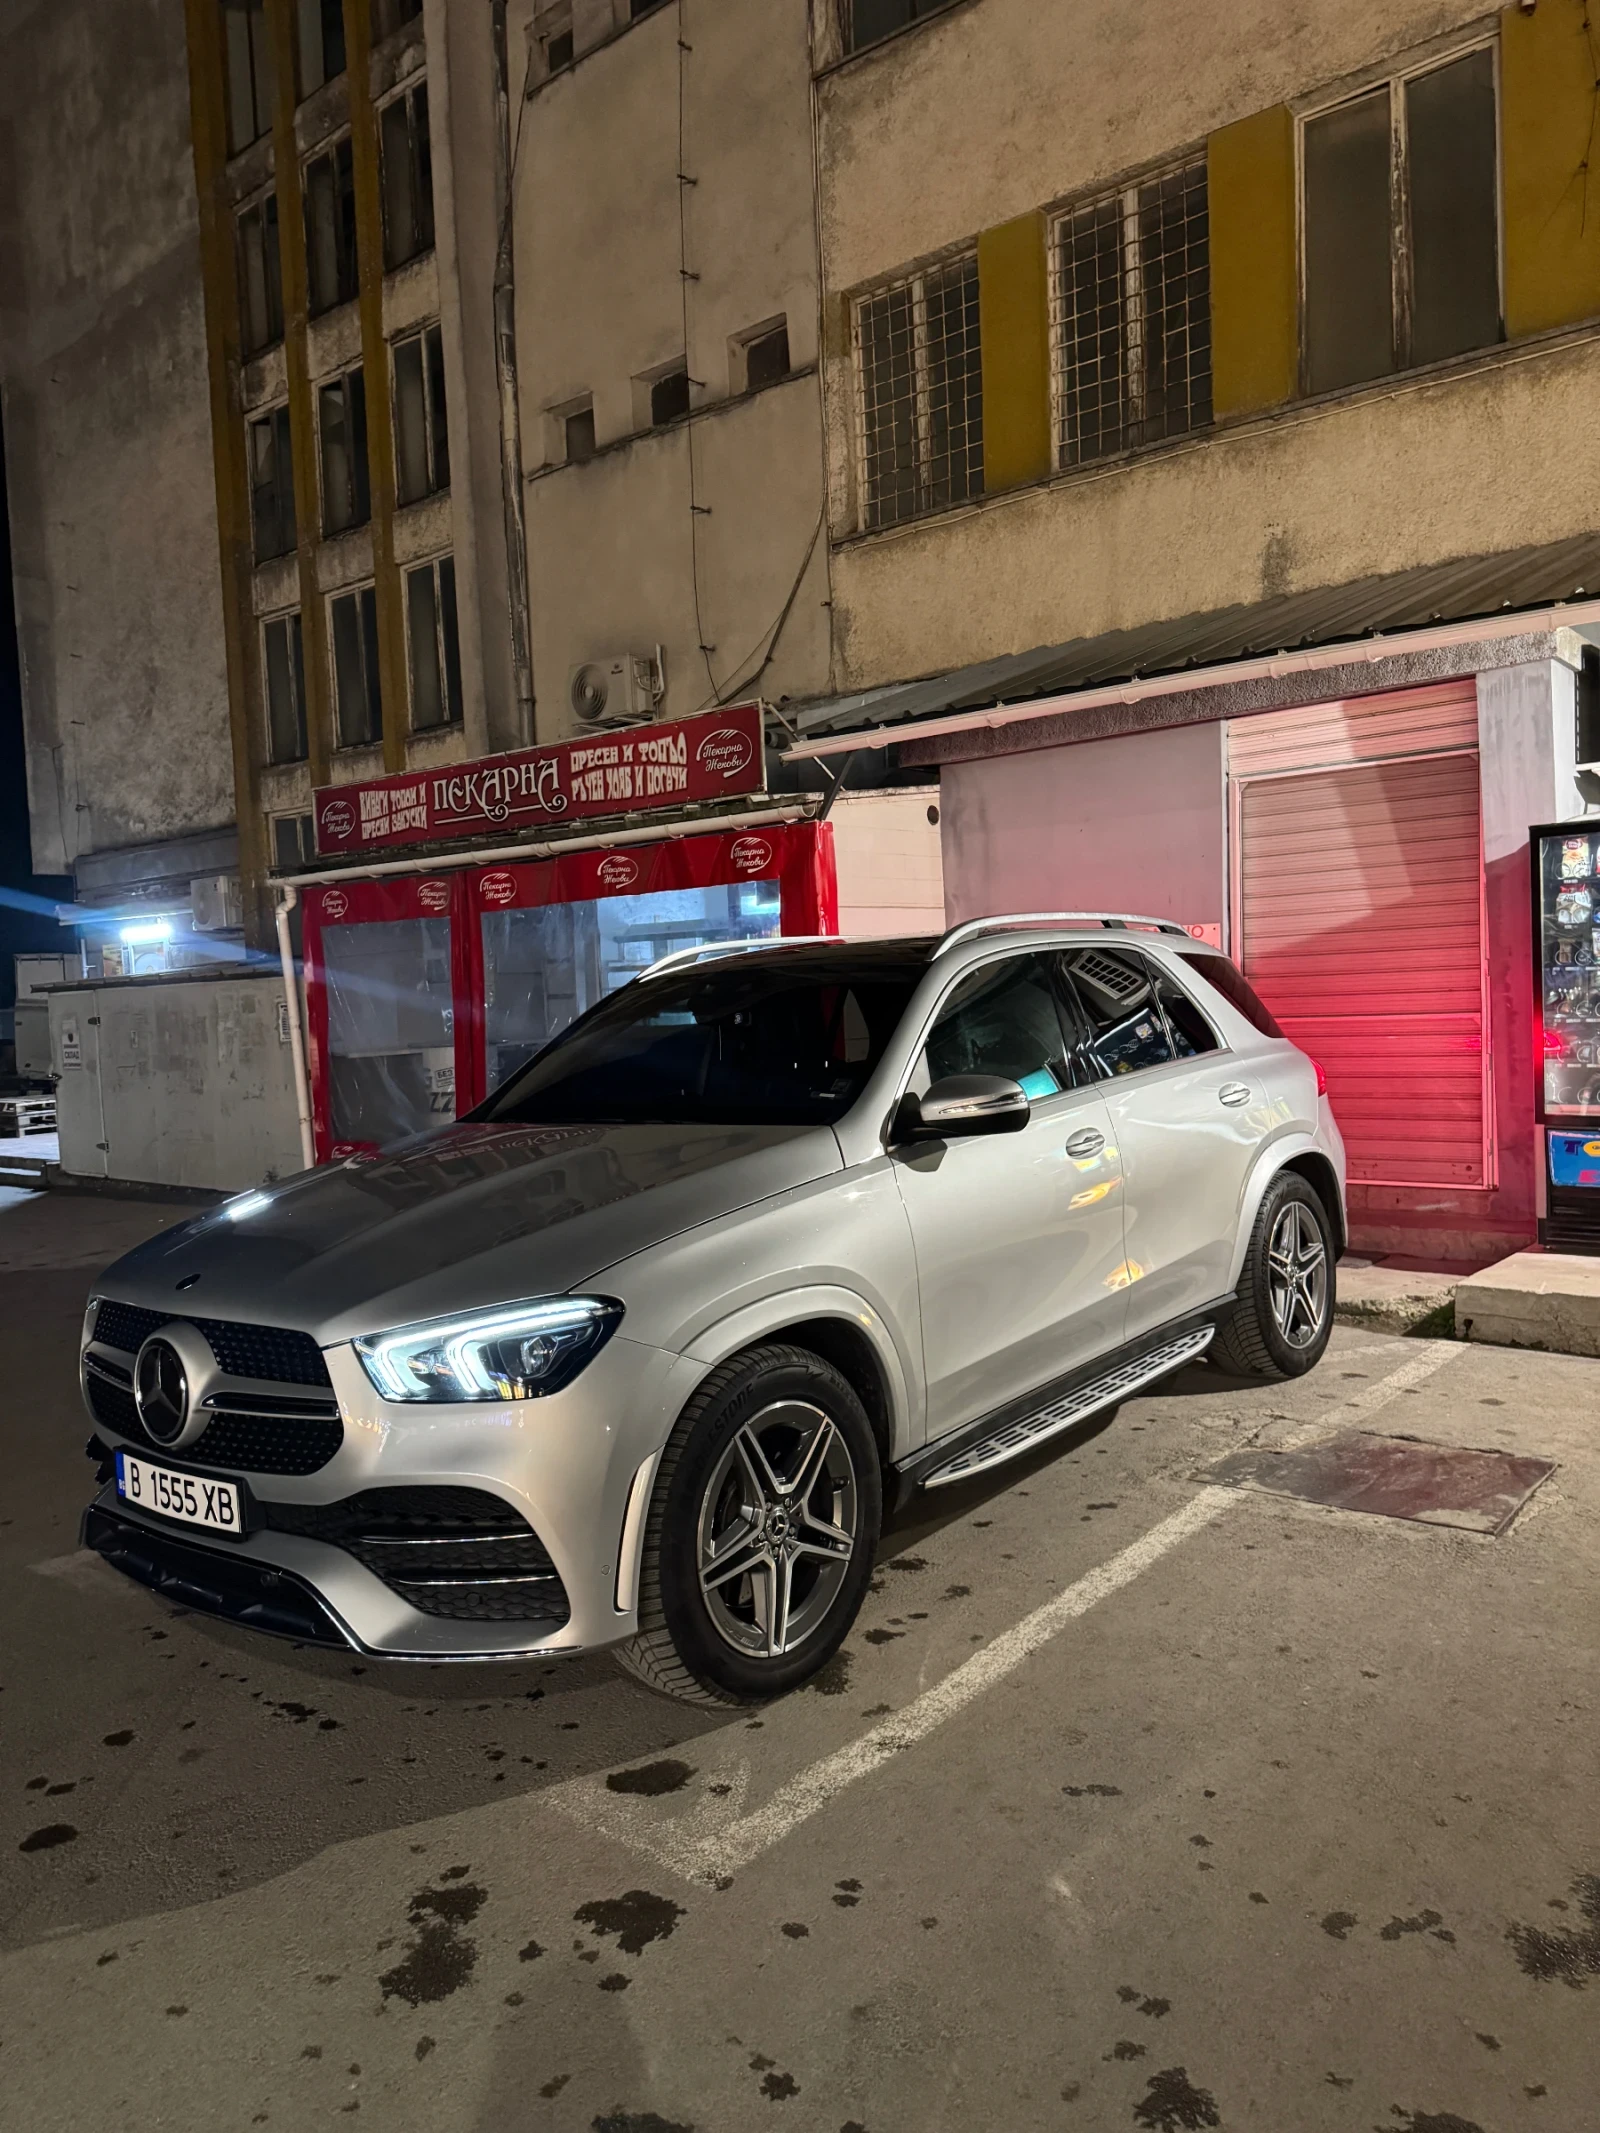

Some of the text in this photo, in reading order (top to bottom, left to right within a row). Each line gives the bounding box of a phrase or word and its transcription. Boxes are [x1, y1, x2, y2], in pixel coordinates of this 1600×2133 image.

[570, 746, 619, 773] ПРЕСЕН
[622, 744, 634, 762] И
[703, 744, 743, 759] Пекарна
[705, 755, 743, 772] Жекови
[418, 781, 427, 803] И
[432, 757, 568, 822] ПЕКАРНА
[571, 769, 605, 801] РЪЧЕН
[634, 766, 644, 797] И
[646, 765, 688, 796] ПОГАЧИ
[361, 805, 428, 840] ПРЕСНИ ЗАКУСКИ
[130, 1462, 141, 1498] B
[151, 1470, 198, 1517] 1555
[202, 1483, 234, 1525] XB
